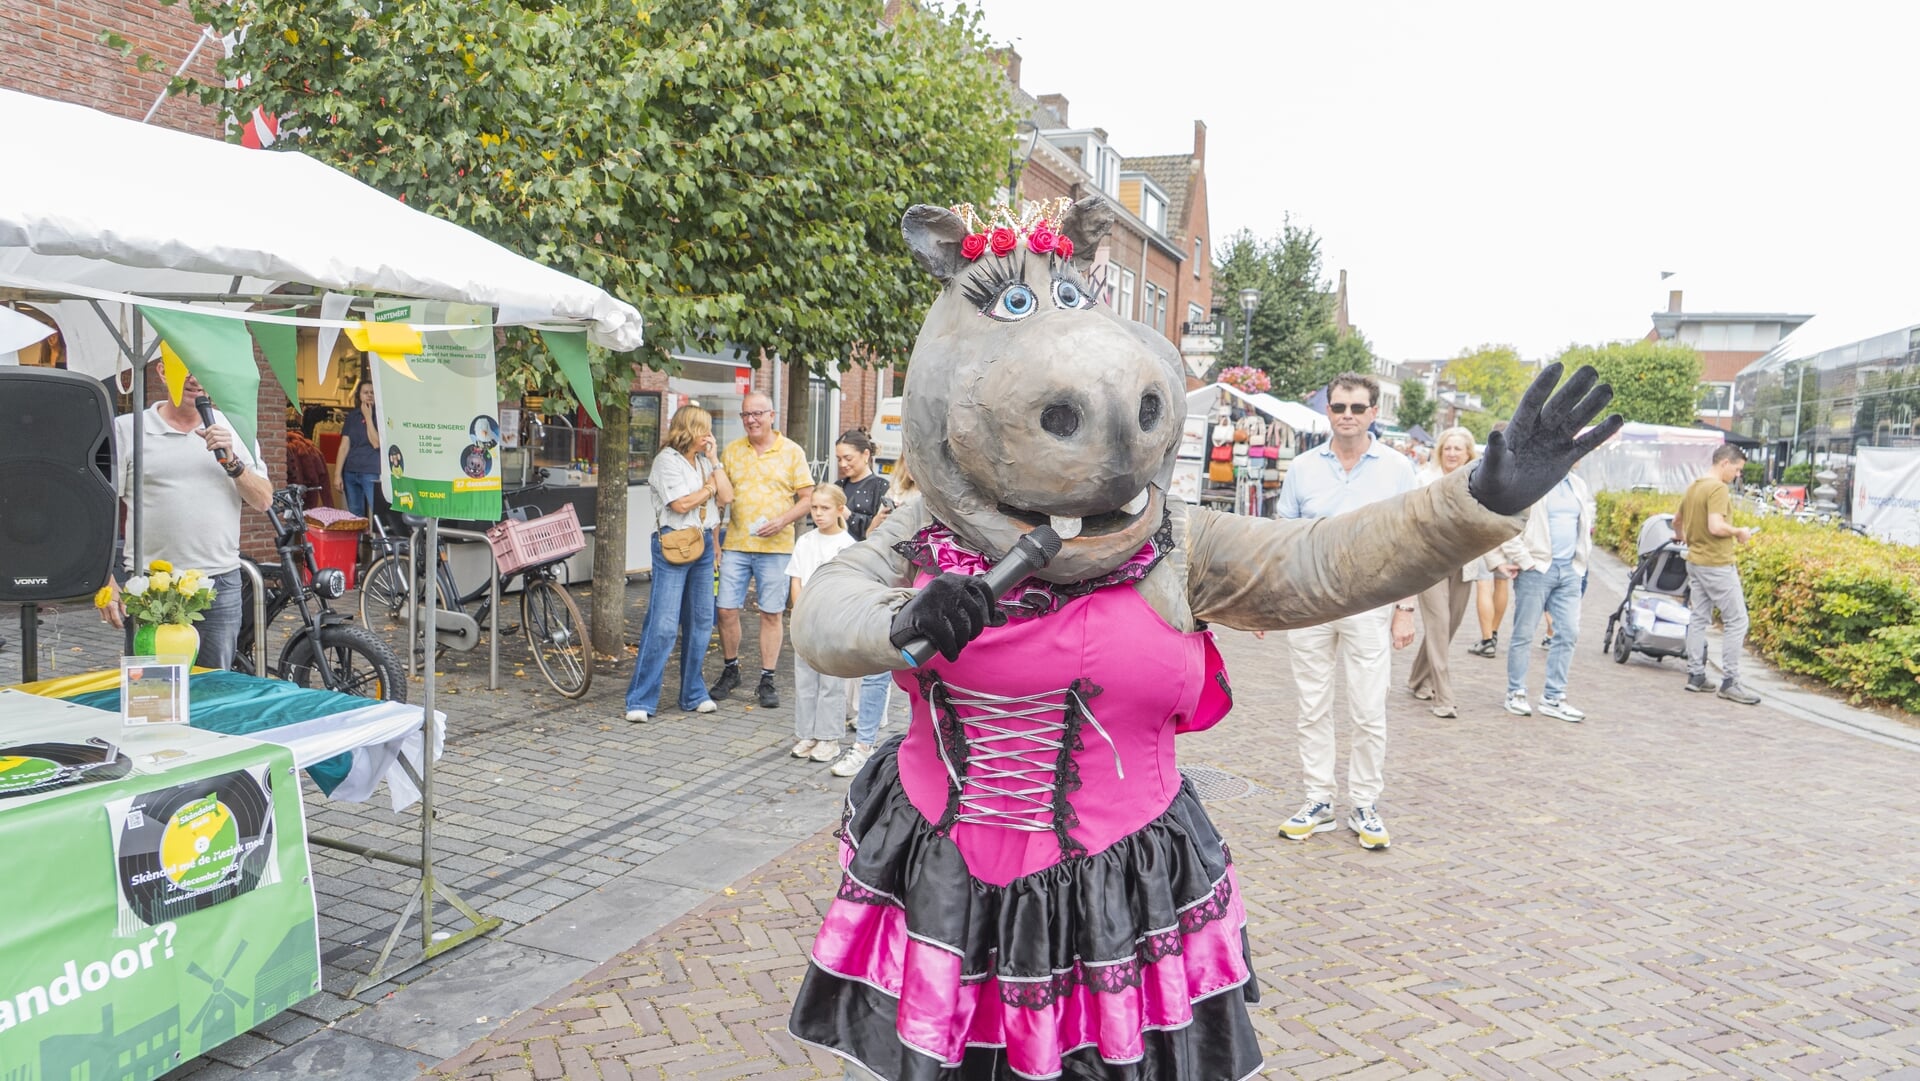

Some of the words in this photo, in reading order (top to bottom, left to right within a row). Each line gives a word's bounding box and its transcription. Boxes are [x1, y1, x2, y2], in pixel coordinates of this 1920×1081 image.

[131, 864, 177, 886] Skèndel
[198, 856, 211, 866] de
[167, 883, 179, 892] 27
[180, 871, 220, 888] december
[221, 862, 239, 875] 2025
